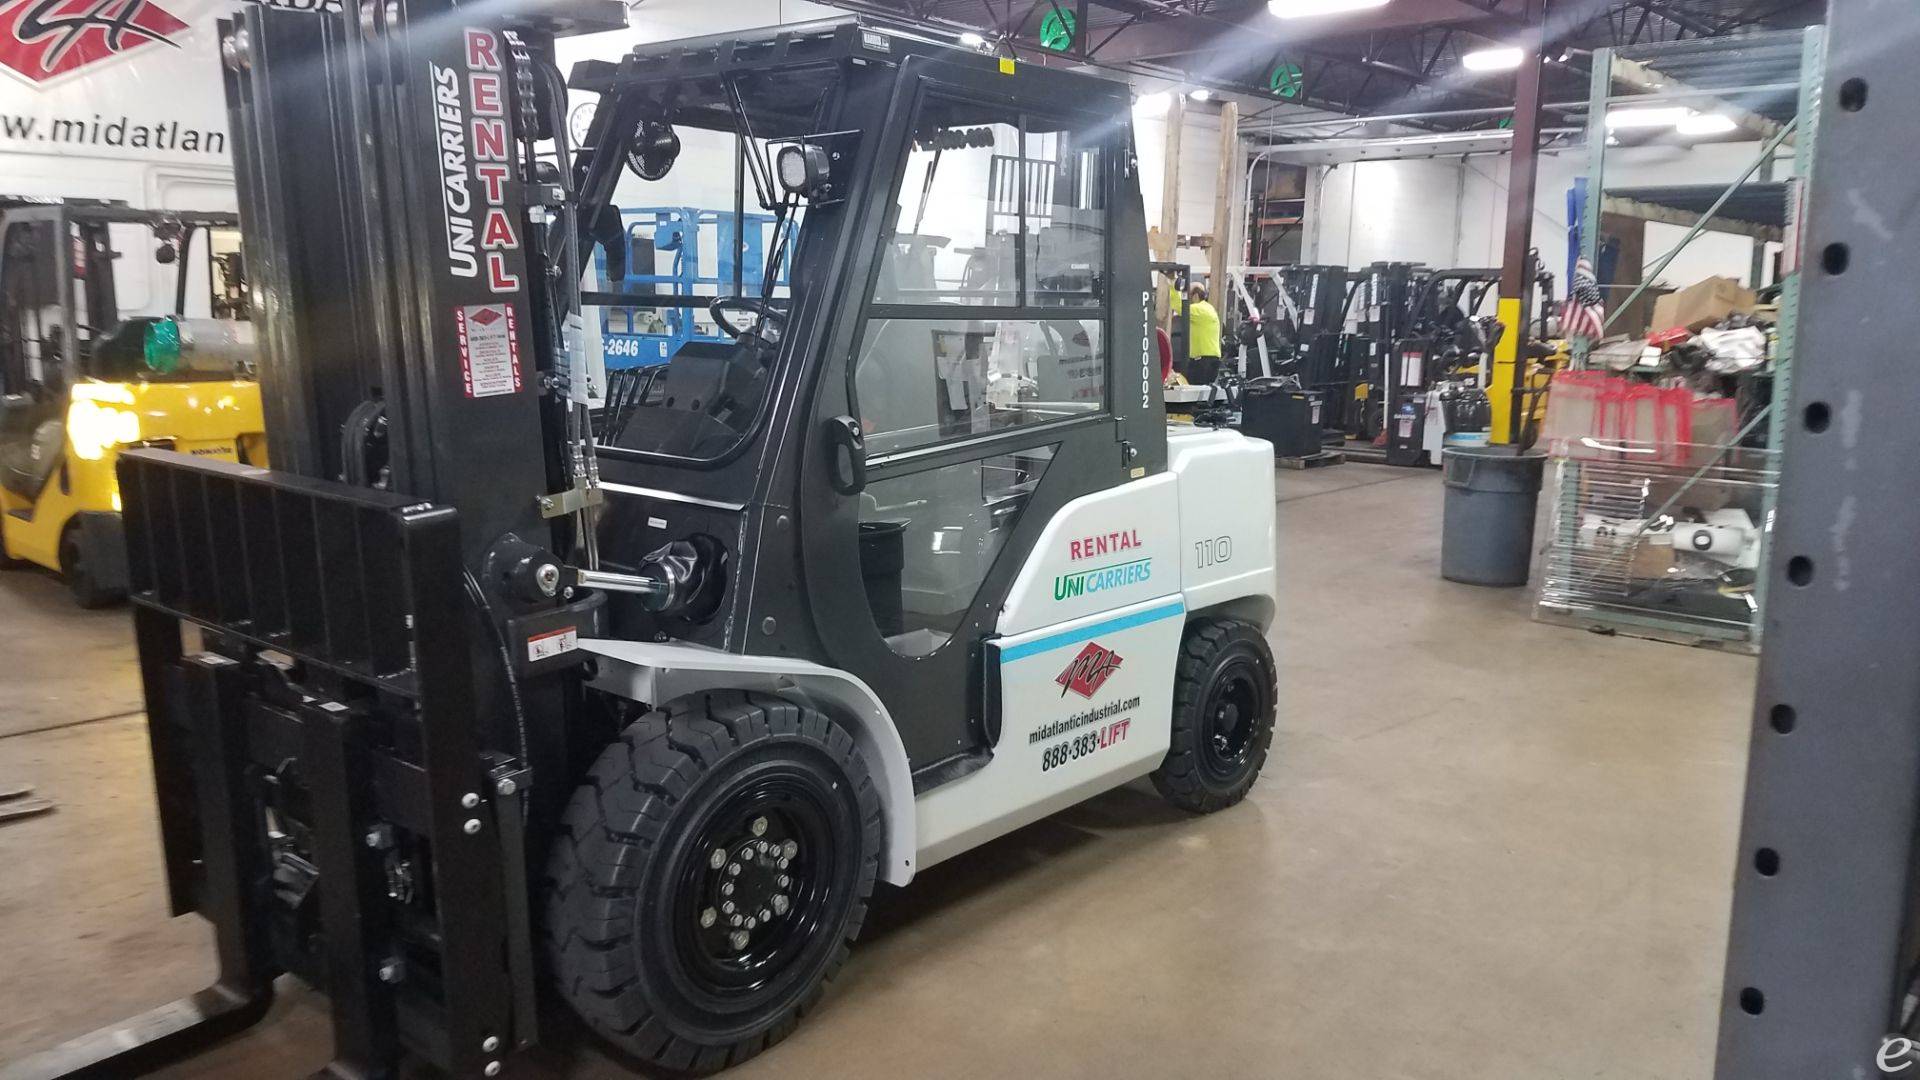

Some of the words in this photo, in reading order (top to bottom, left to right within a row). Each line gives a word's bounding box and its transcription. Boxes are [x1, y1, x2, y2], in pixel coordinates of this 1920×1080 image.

[464, 27, 519, 293] RENTAL
[457, 310, 472, 394] SERVICE
[506, 306, 521, 387] RENTALS
[1142, 291, 1150, 409] P1100002
[1070, 529, 1142, 561] RENTAL
[1195, 535, 1232, 569] 110
[1029, 697, 1140, 745] midatlanticindustrial.com
